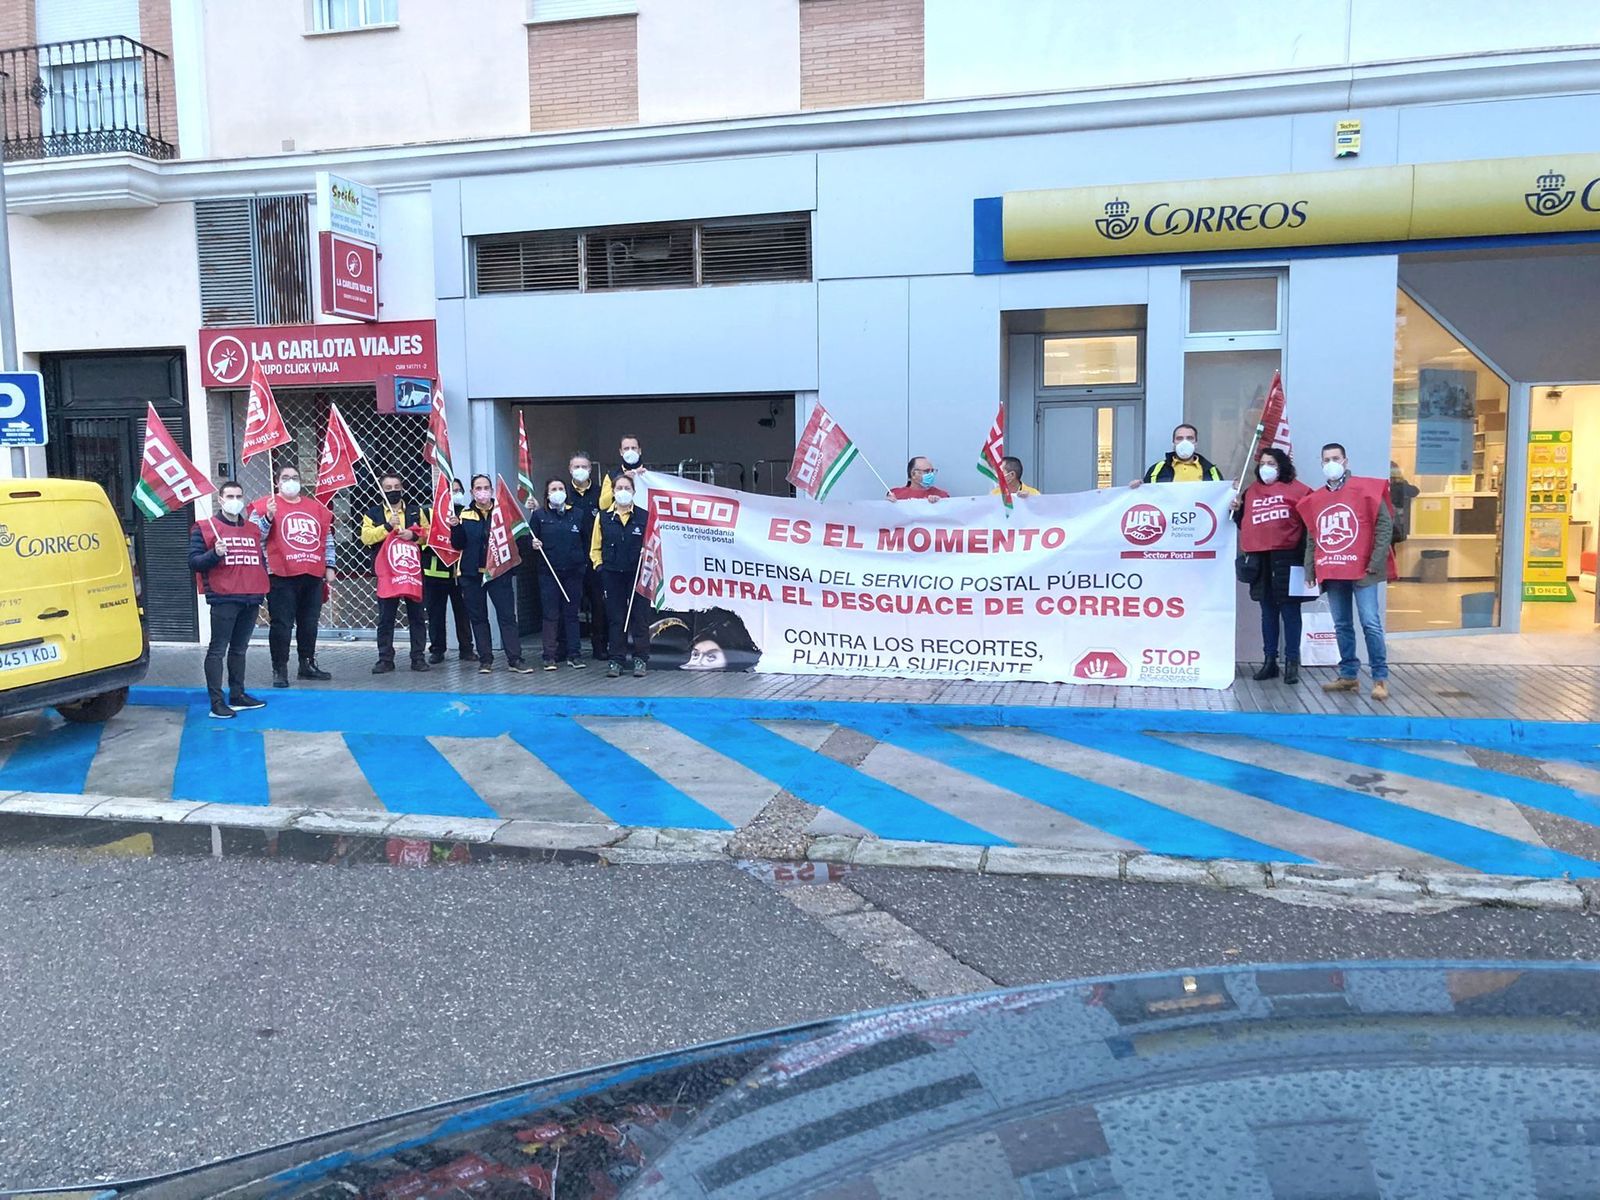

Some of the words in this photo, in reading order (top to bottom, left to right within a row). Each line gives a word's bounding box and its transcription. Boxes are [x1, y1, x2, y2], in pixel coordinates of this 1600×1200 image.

[1144, 200, 1309, 236] CORREOS
[251, 341, 274, 361] LA
[277, 338, 356, 361] CARLOTA
[359, 335, 423, 357] VIAJES
[259, 363, 283, 375] RUPO
[284, 362, 311, 374] CLICK
[312, 362, 340, 374] VIAJA
[143, 427, 202, 504] COO
[652, 495, 734, 523] CCOO
[1252, 509, 1291, 525] CCOO
[286, 518, 317, 536] UGT
[660, 523, 680, 531] vicios
[1126, 510, 1161, 528] UGT
[490, 499, 512, 565] COO
[683, 533, 710, 541] correos
[712, 535, 735, 544] postal
[768, 518, 811, 544] ES
[823, 523, 864, 549] EL
[876, 527, 1067, 554] MOMENTO
[15, 532, 100, 558] CORREOS
[391, 543, 419, 561] UGT
[225, 555, 260, 566] CCOO
[1143, 551, 1168, 560] Sector
[1170, 551, 1195, 560] Postal
[1333, 554, 1358, 562] mano
[704, 557, 726, 574] EN
[732, 560, 813, 583] DEFENSA
[819, 569, 856, 587] DEL
[861, 573, 954, 591] SERVICIO
[961, 575, 1040, 592] POSTAL
[1048, 571, 1143, 591] PÚBLICO
[99, 598, 129, 609] RENAULT
[670, 575, 774, 602] CONTRA
[781, 585, 813, 606] EL
[822, 589, 973, 616] DESGUACE
[985, 597, 1024, 615] DE
[1035, 595, 1186, 618] CORREOS
[33, 645, 58, 662] KDJ
[784, 628, 867, 651] CONTRA
[873, 636, 914, 654] LOS
[921, 639, 1044, 662] RECORTES,
[793, 650, 900, 669] PLANTILLA
[907, 656, 1034, 674] SUFICIENTE
[1142, 648, 1201, 666] STOP
[1140, 665, 1201, 675] DESGUACE
